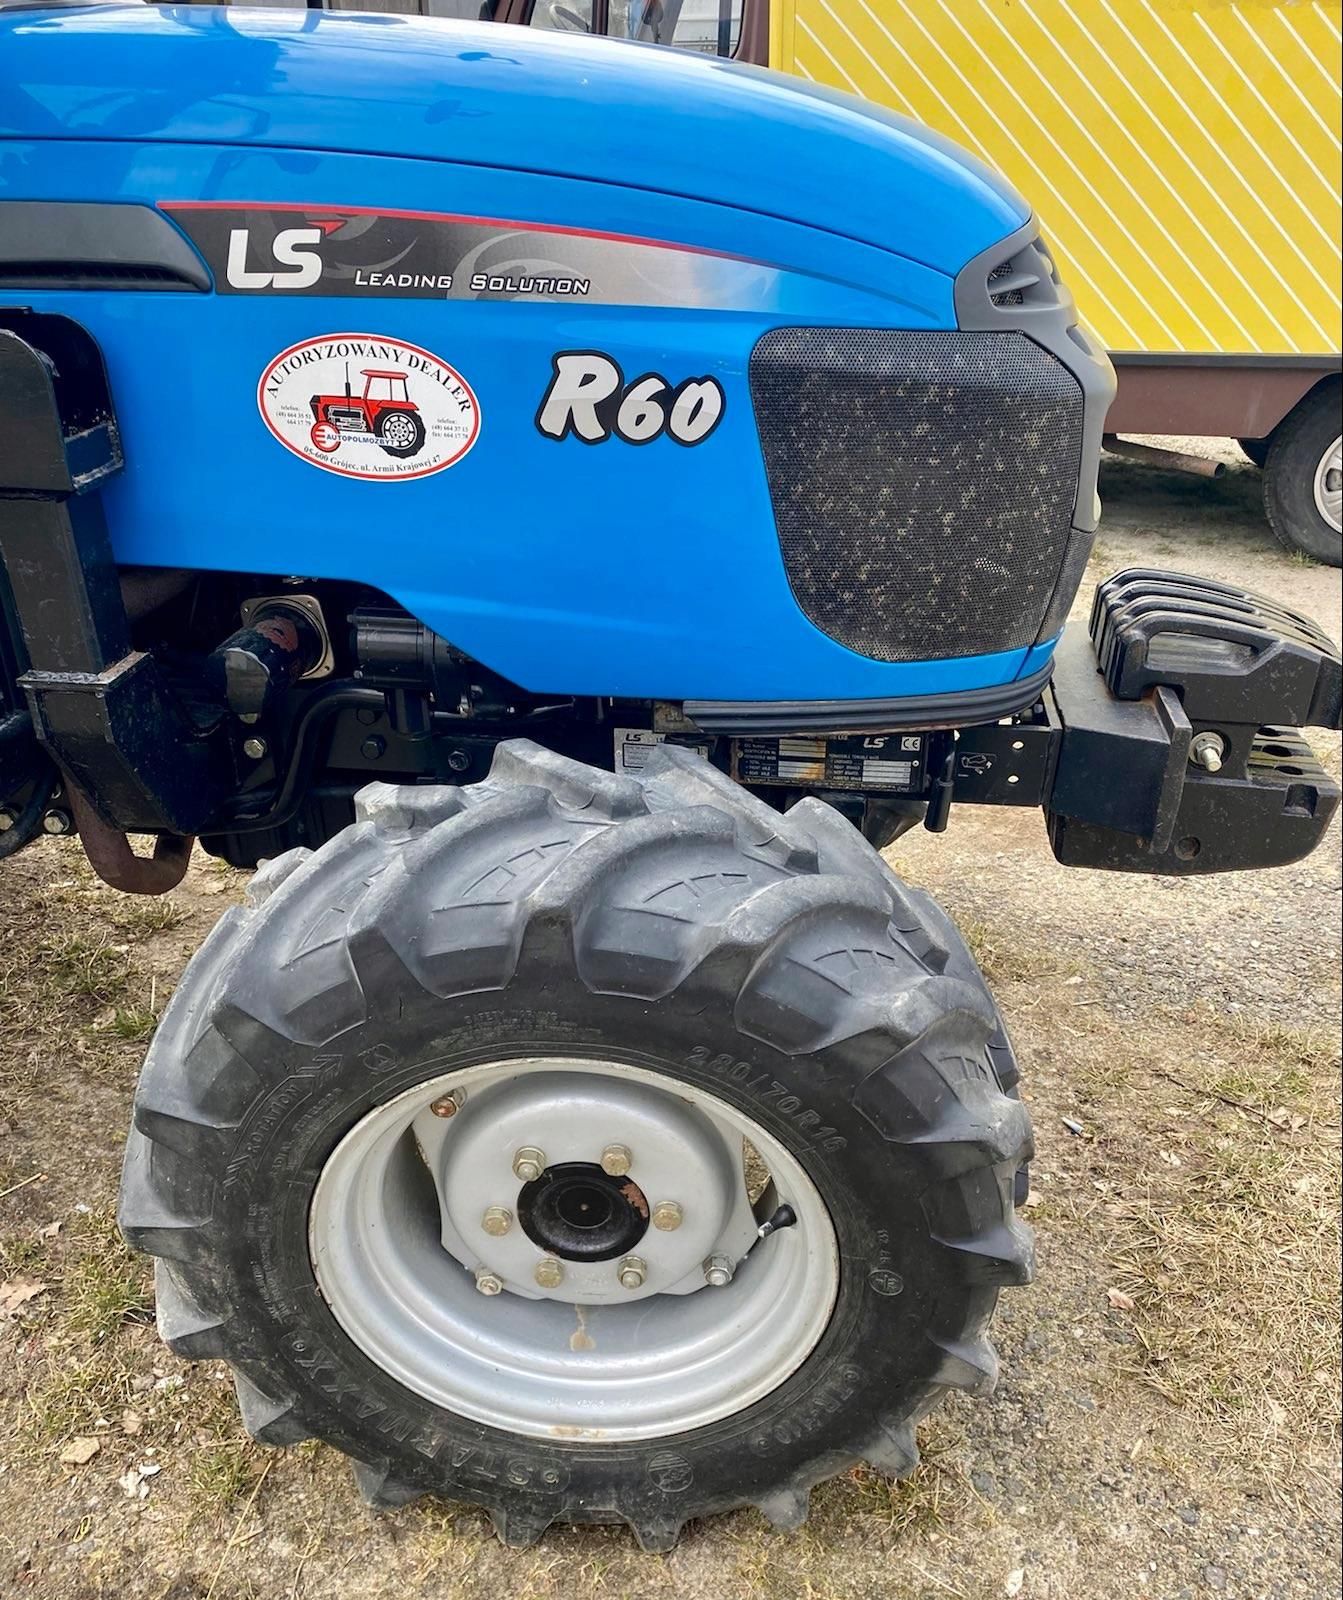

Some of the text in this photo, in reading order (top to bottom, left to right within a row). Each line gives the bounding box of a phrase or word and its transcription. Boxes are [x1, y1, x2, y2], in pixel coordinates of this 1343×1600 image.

[226, 228, 323, 289] LS
[354, 269, 591, 296] LEADING SOLUTION
[266, 342, 472, 413] AUTORYZOWANY DEALER
[537, 351, 727, 447] R60
[303, 446, 329, 461] 05-600
[372, 464, 395, 473] Armii
[395, 457, 432, 472] Krajowej
[432, 454, 442, 464] 47
[326, 433, 396, 446] AUTOPOLMOZBYT
[625, 733, 645, 742] LS
[863, 737, 886, 749] LS
[903, 738, 919, 750] CE
[246, 1083, 303, 1154] ROTATION
[686, 1045, 849, 1153] 280/70R16
[293, 1348, 539, 1486] STARMAXX
